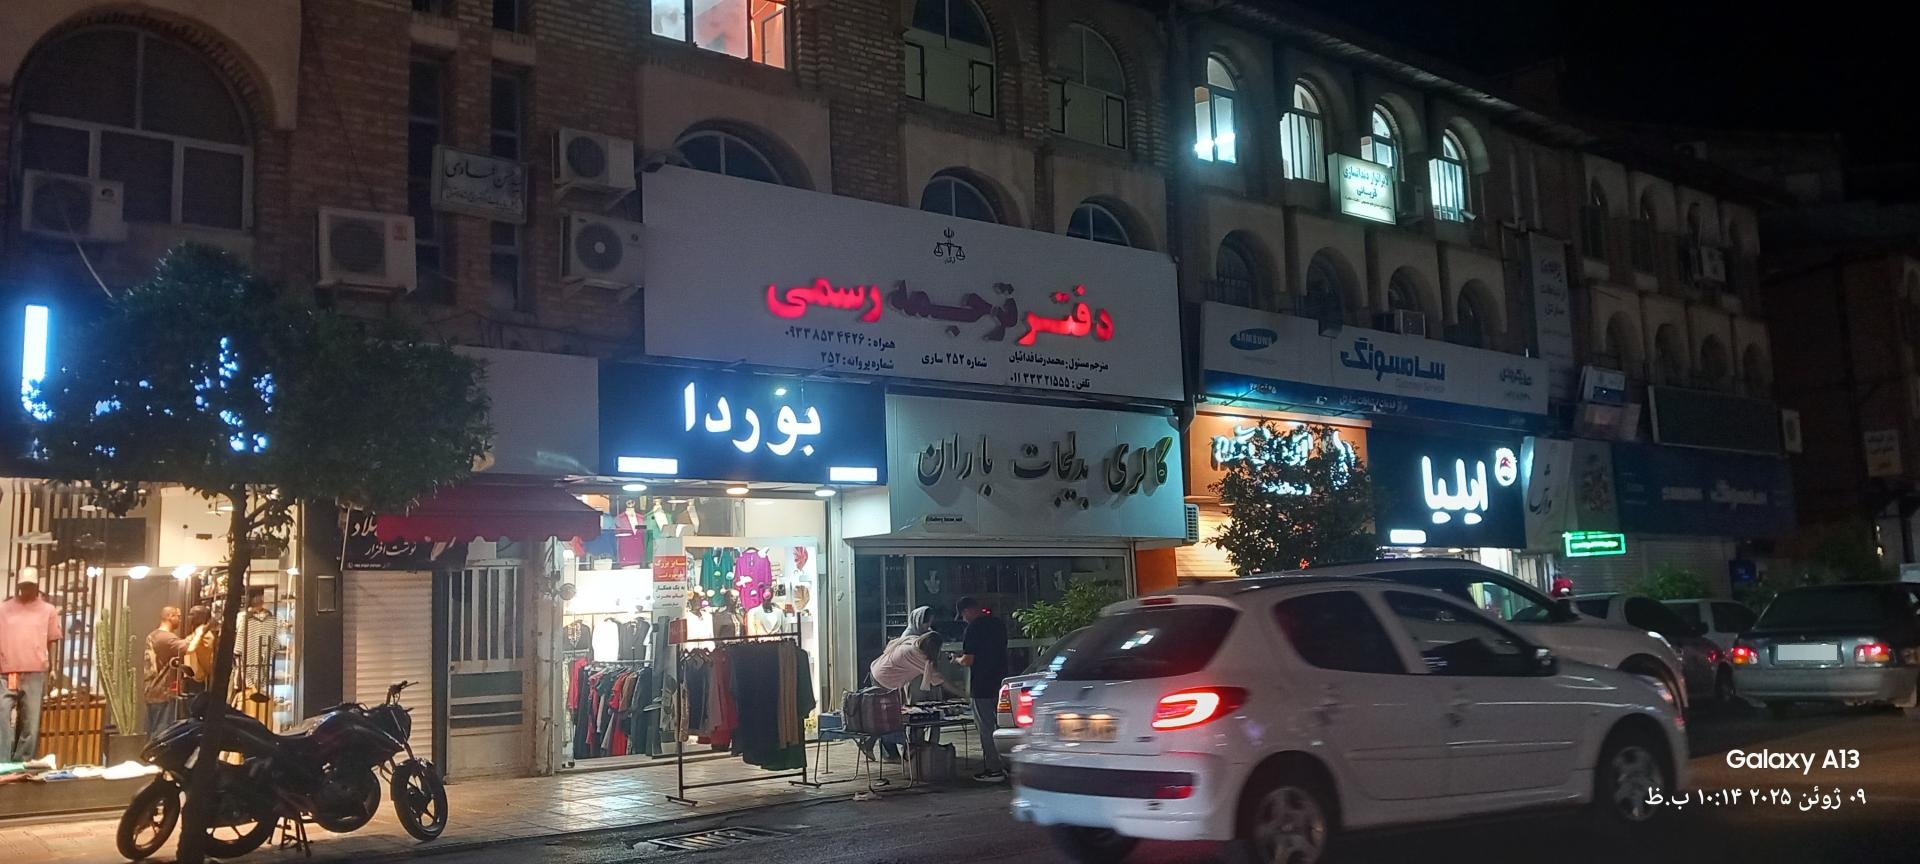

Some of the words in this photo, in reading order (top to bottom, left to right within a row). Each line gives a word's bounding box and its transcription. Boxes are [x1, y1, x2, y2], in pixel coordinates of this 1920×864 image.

[767, 277, 884, 323] رسمی
[886, 279, 1020, 342] ترجمه
[1016, 284, 1114, 347] دفتر
[874, 358, 894, 371] شماره
[921, 352, 944, 366] ساری
[966, 356, 988, 369] شماره
[1090, 361, 1109, 373] مترجم
[1340, 337, 1446, 382] سامسونگ
[684, 381, 823, 457] بوردا
[917, 432, 994, 498] باران
[1009, 430, 1090, 511] بدلیجات
[1104, 436, 1173, 496] گالری
[1421, 455, 1488, 525] ایلیا
[364, 541, 386, 560] افزار
[386, 541, 417, 556] نوشت
